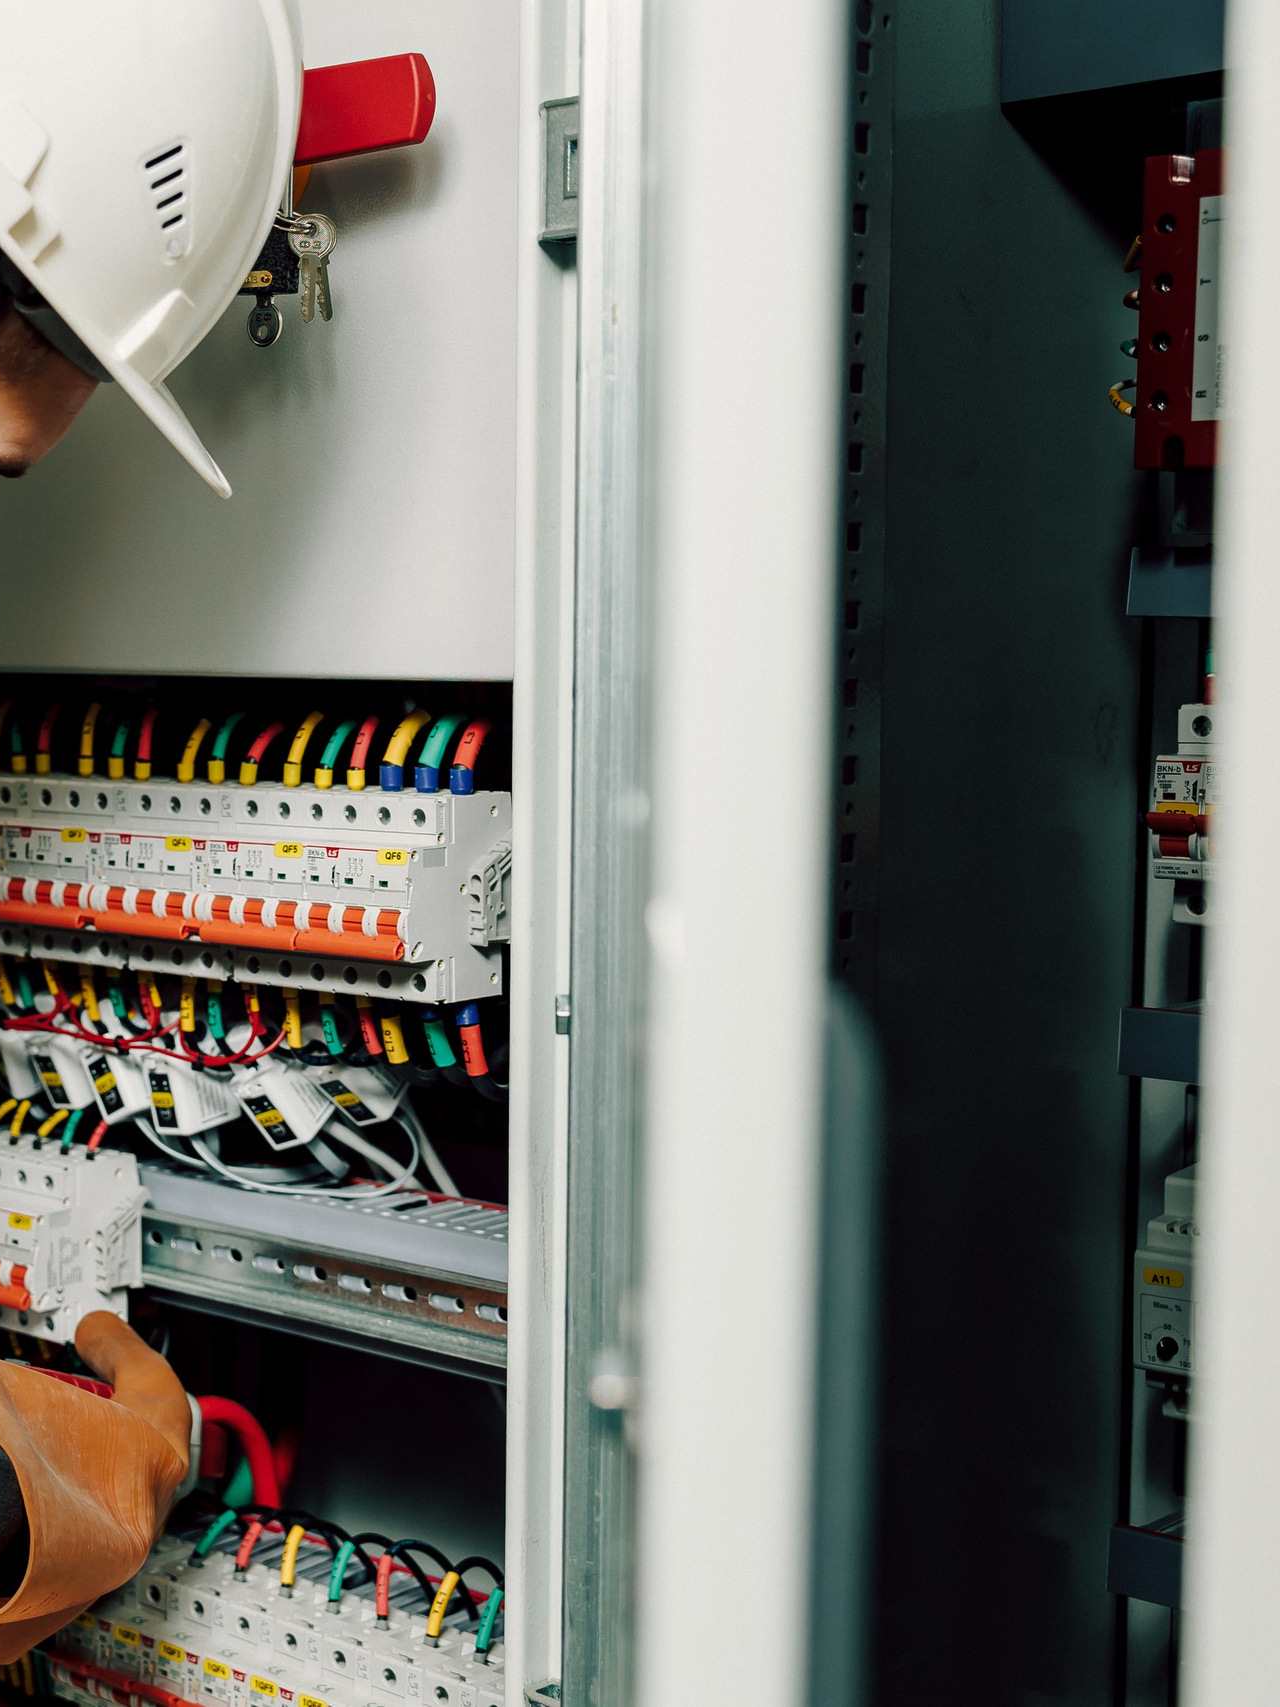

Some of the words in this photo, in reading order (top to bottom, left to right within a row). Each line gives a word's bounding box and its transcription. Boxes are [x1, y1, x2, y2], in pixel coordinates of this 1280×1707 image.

[1200, 278, 1211, 286] T
[1198, 334, 1209, 342] S
[1195, 390, 1207, 398] R
[464, 731, 476, 745] L3
[1157, 765, 1182, 773] BKN-b
[1186, 764, 1198, 772] LS
[172, 838, 187, 847] QF4
[282, 844, 298, 854] QF5
[328, 849, 338, 857] LS
[385, 851, 402, 861] QF6
[322, 1018, 335, 1045] L2.5
[384, 1028, 396, 1053] L1.6
[1152, 1274, 1170, 1285] A11
[1175, 1304, 1182, 1312] %
[1182, 1337, 1191, 1346] 75
[1179, 1360, 1191, 1368] 100
[206, 1661, 227, 1675] 1QF4
[253, 1678, 274, 1693] 1QF5
